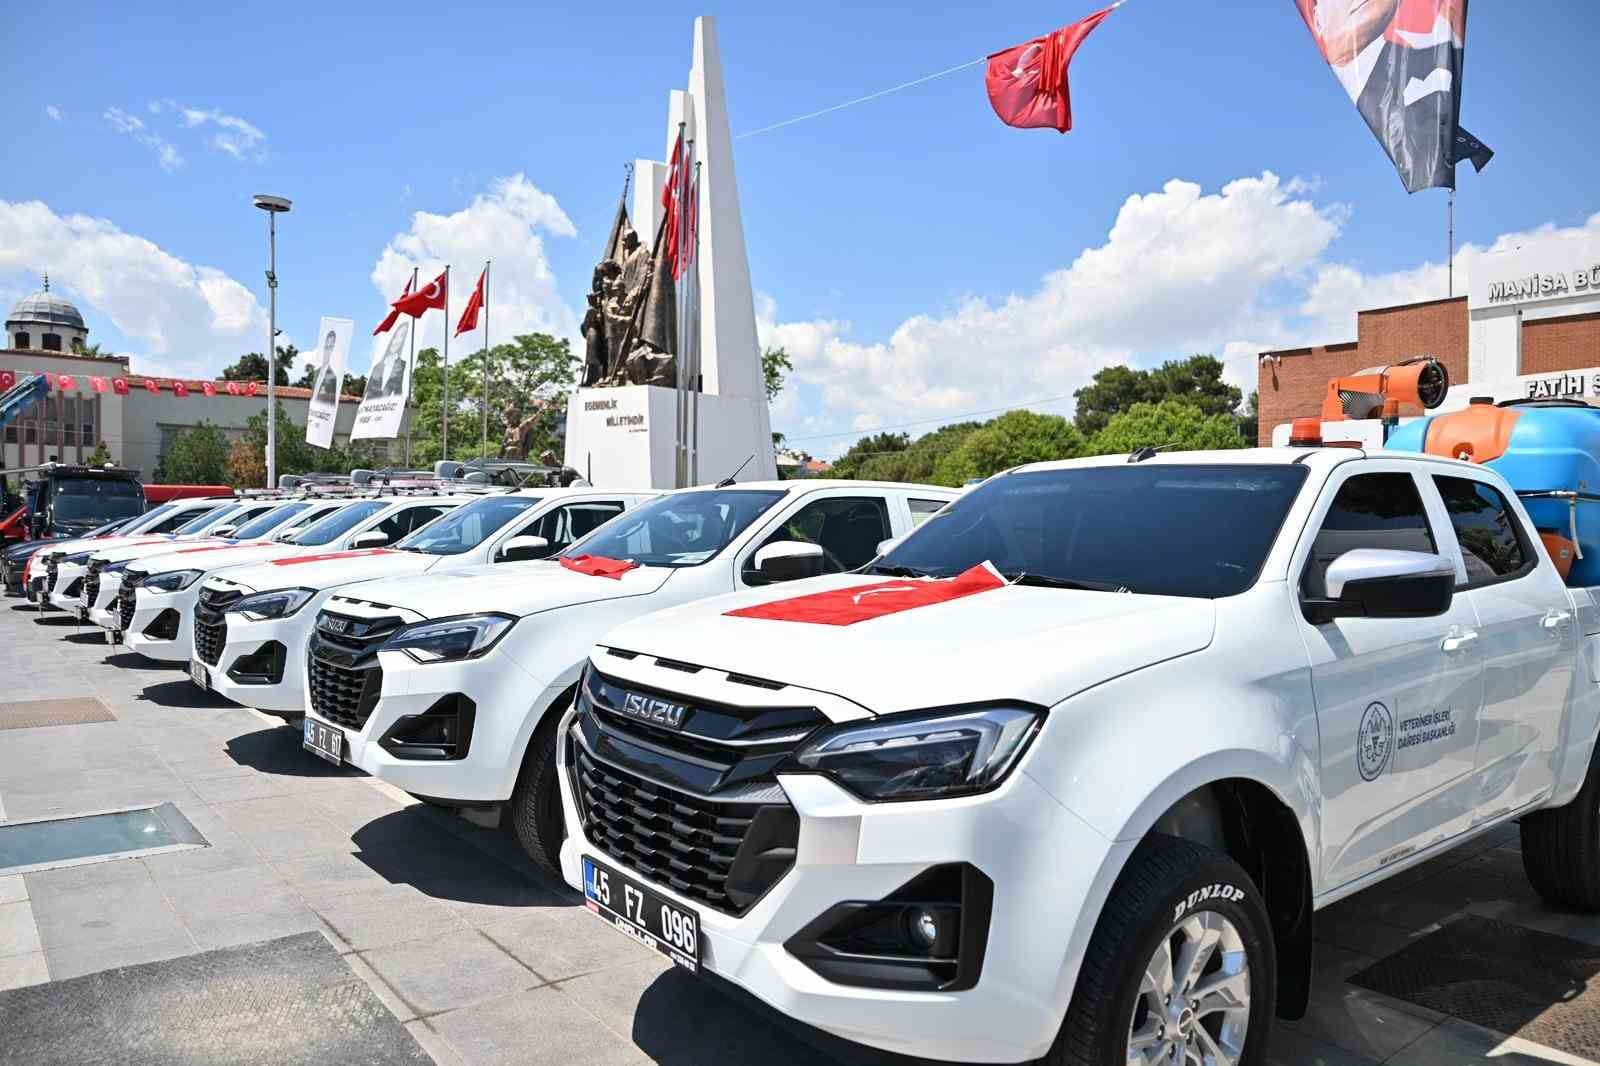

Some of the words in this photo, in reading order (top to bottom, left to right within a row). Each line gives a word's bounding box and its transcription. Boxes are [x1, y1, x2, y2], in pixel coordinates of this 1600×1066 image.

[1488, 272, 1569, 301] MANİSA
[1526, 373, 1585, 399] FATİH
[622, 693, 684, 726] ISUZU
[593, 867, 610, 905] 45
[624, 883, 647, 928] FZ
[661, 904, 696, 954] 096
[1173, 884, 1246, 922] DUNLOP
